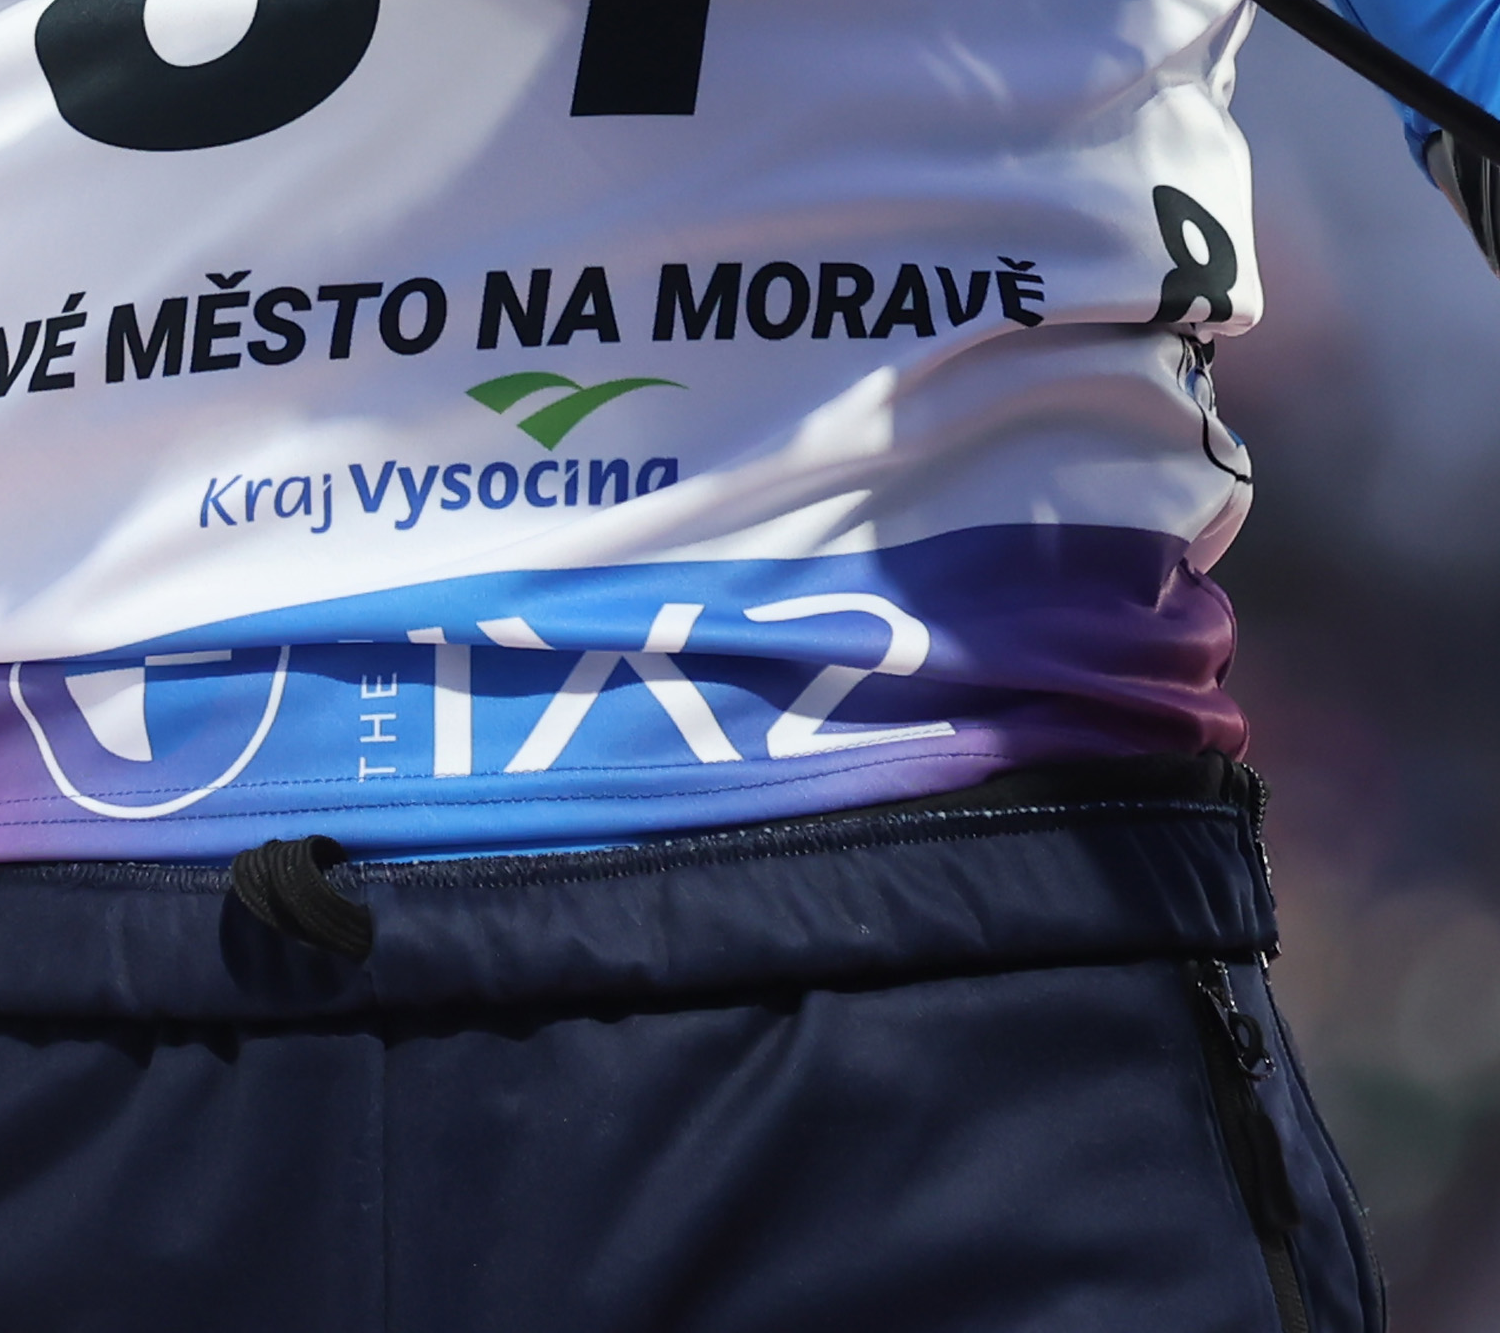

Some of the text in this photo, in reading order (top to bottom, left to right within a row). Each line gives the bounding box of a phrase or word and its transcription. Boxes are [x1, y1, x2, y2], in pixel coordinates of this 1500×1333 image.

[104, 270, 449, 383] MĚSTO
[476, 266, 621, 351] NA
[651, 255, 1046, 343] MORAVĚ
[199, 471, 333, 534] Kraj
[357, 671, 398, 784] THE
